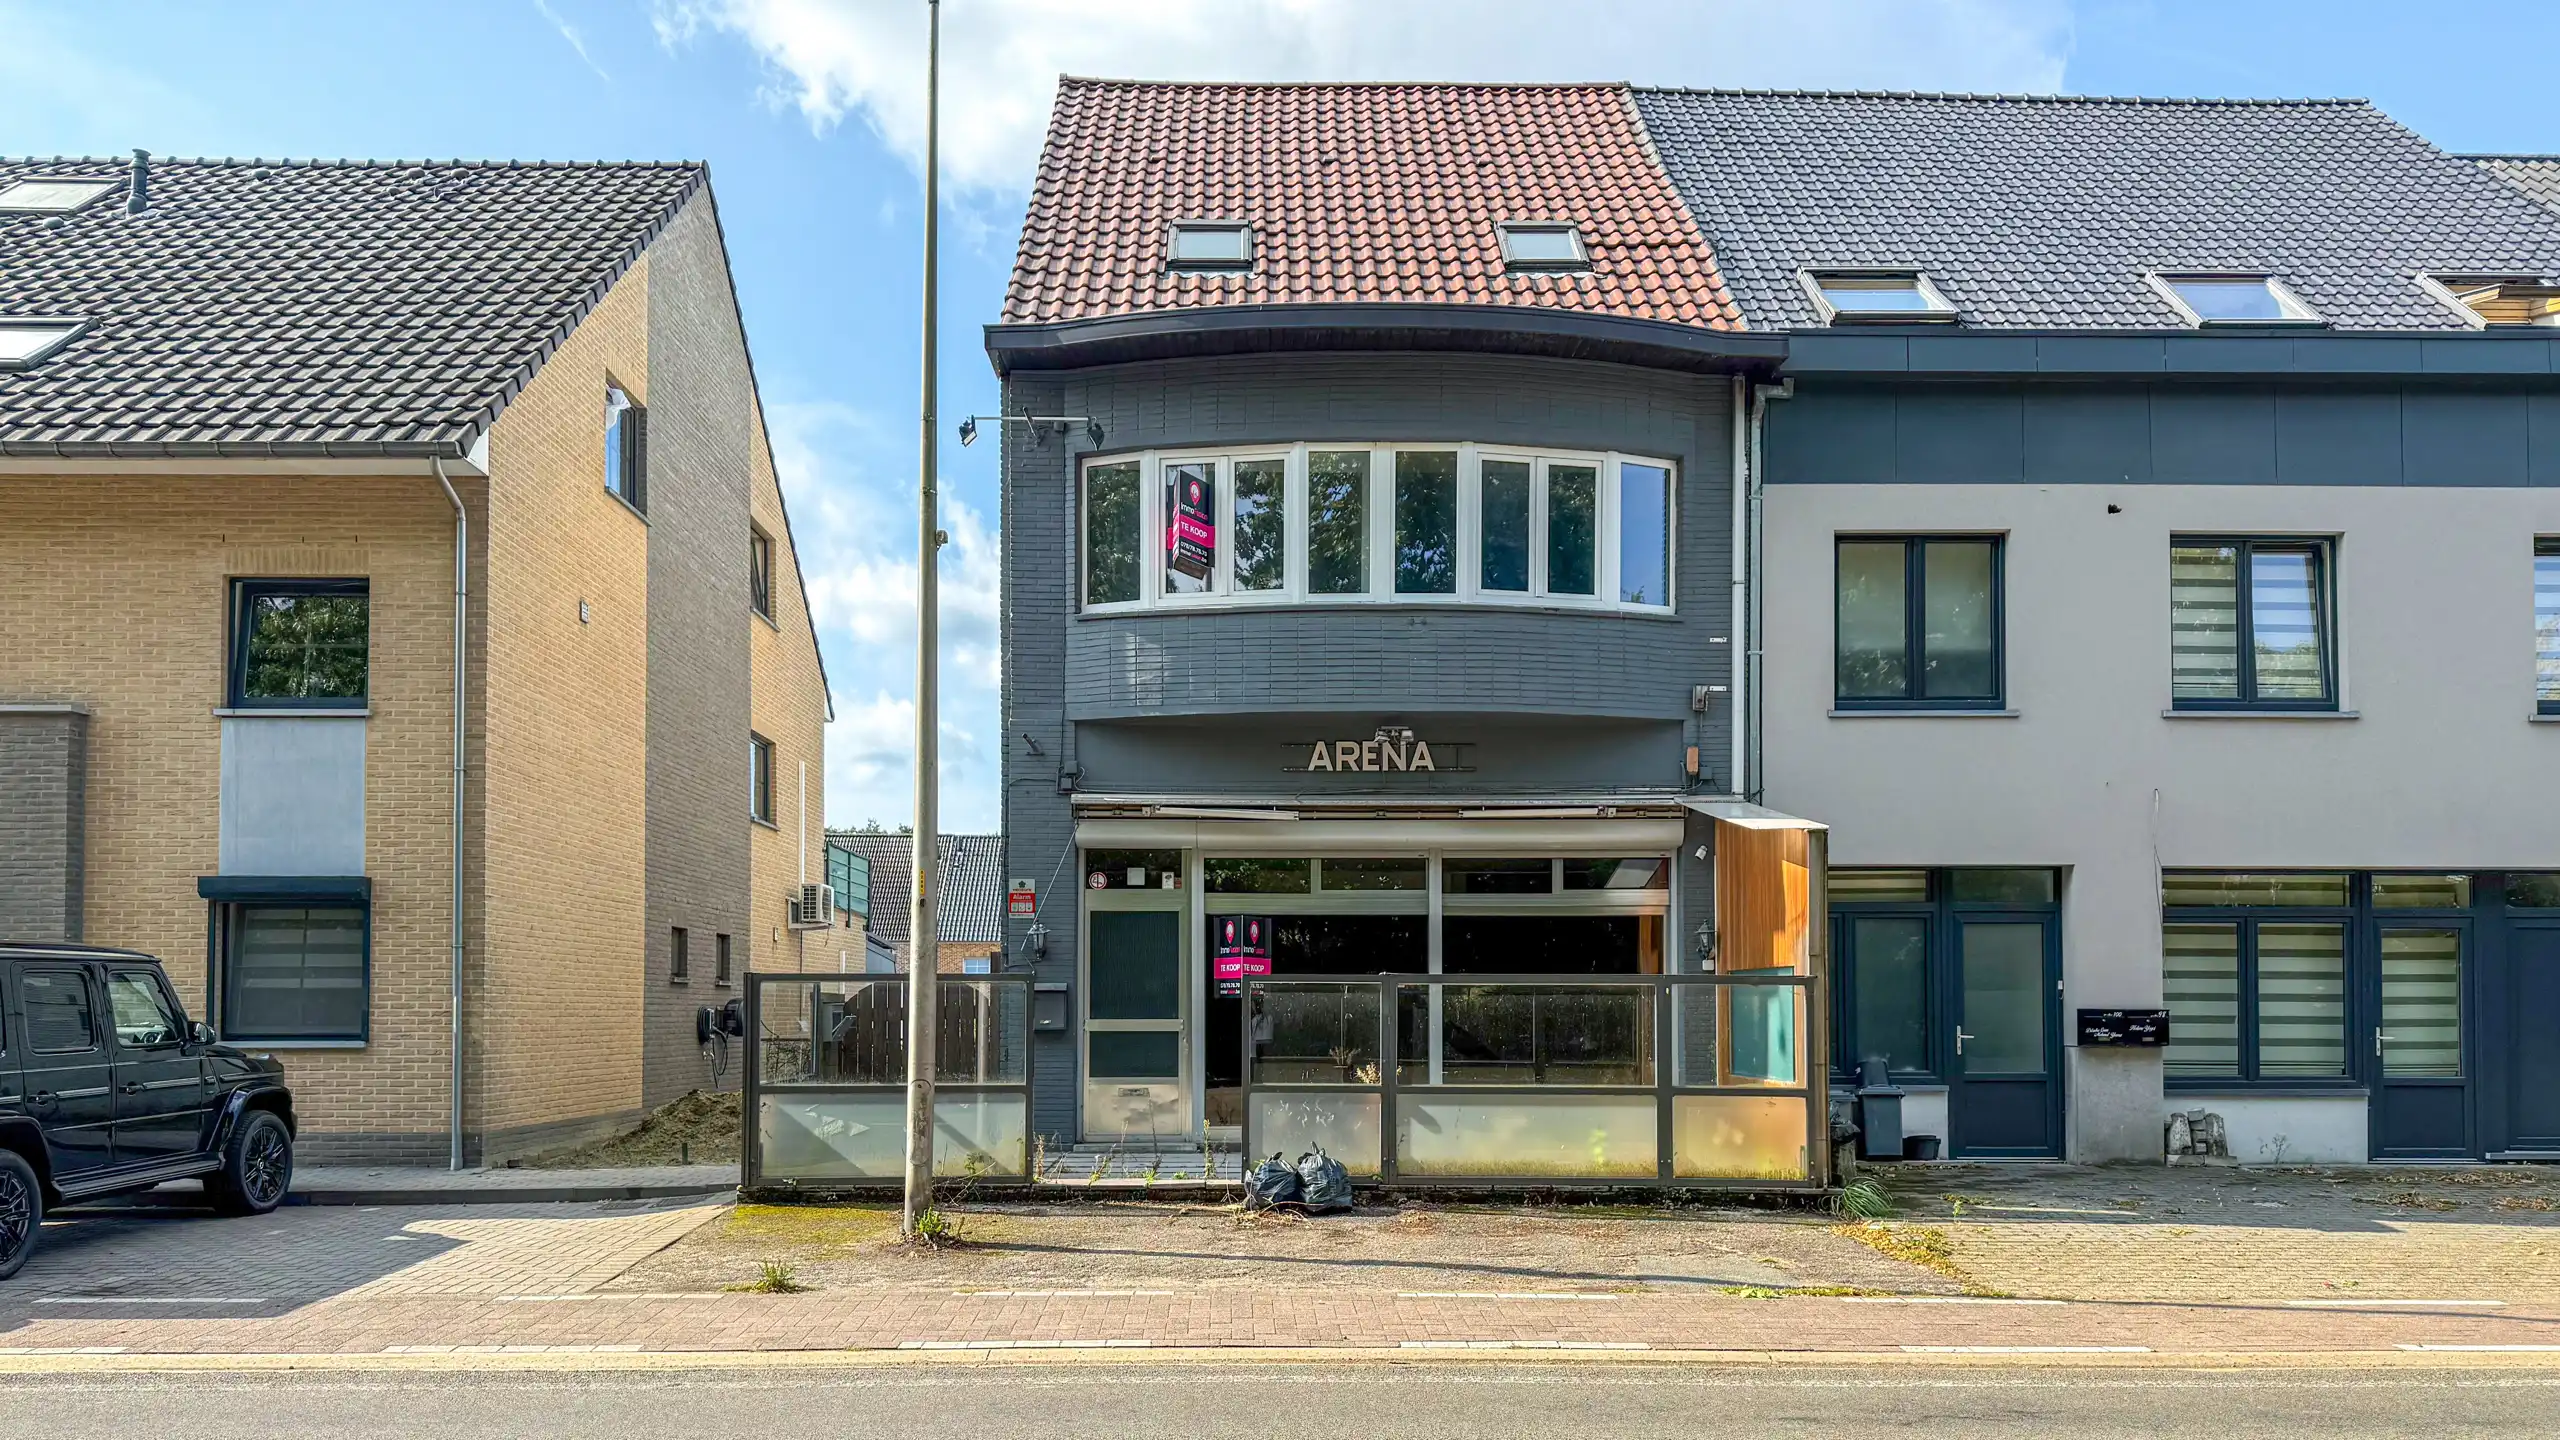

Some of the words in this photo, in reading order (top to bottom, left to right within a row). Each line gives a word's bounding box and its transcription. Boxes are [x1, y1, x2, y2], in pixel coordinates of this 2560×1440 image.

[1181, 521, 1189, 532] TE
[1190, 524, 1208, 539] KOOP
[1308, 740, 1436, 772] ARENA
[1220, 964, 1226, 972] TE
[1226, 963, 1241, 971] KOOP
[1243, 963, 1250, 971] TE
[1250, 964, 1265, 972] KOOP
